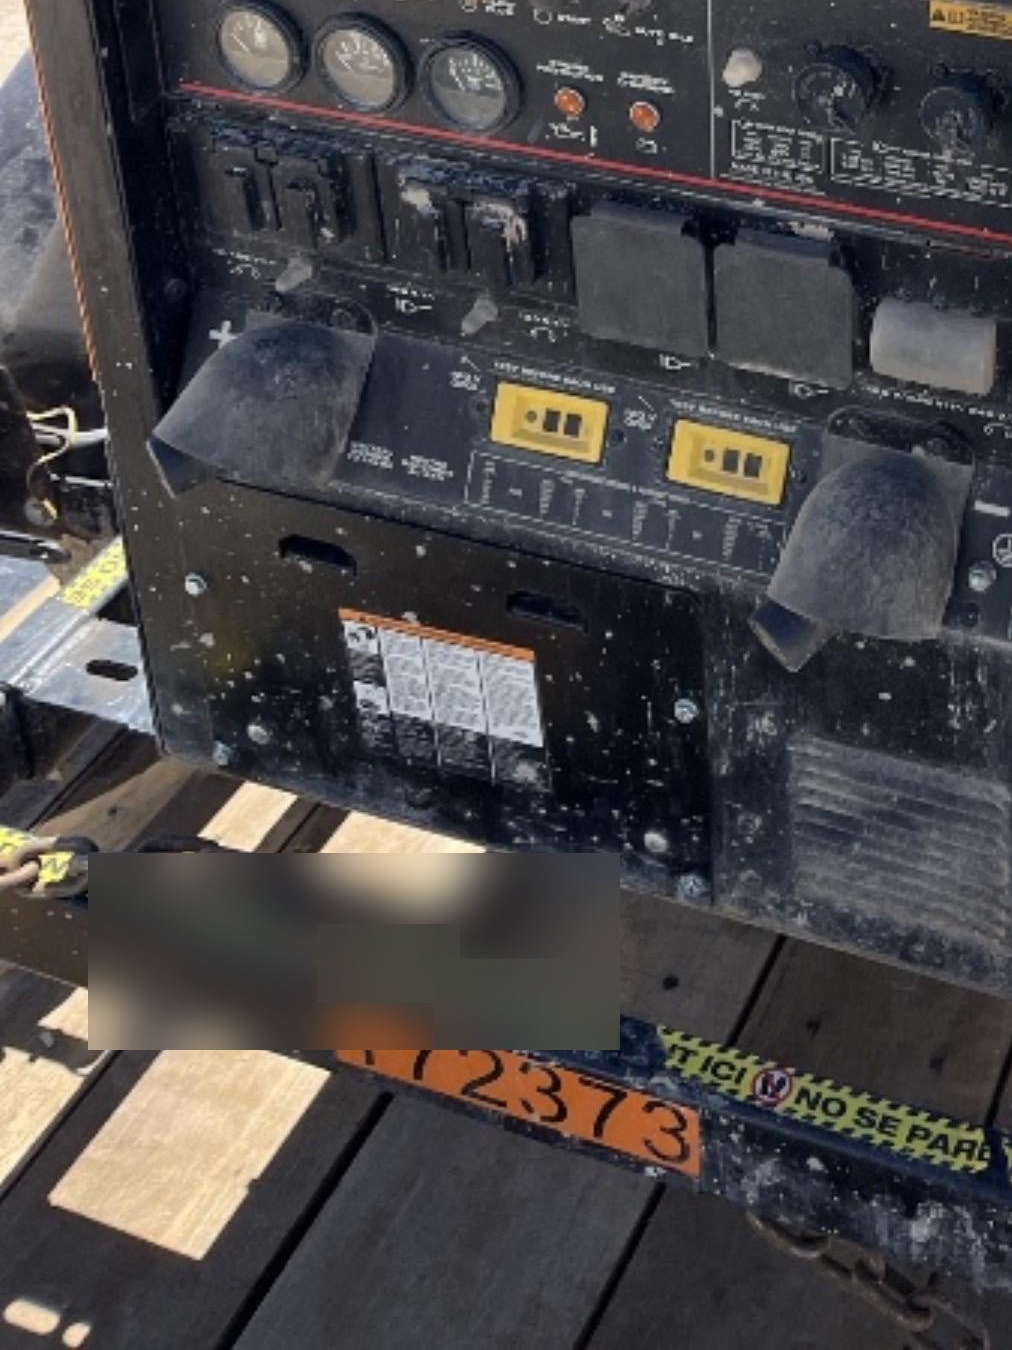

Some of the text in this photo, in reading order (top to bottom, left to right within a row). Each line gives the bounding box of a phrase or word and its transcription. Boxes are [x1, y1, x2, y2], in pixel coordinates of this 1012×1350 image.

[362, 1050, 691, 1164] 2373
[700, 1052, 746, 1087] ICI
[794, 1085, 849, 1121] NO
[853, 1105, 897, 1138] SE
